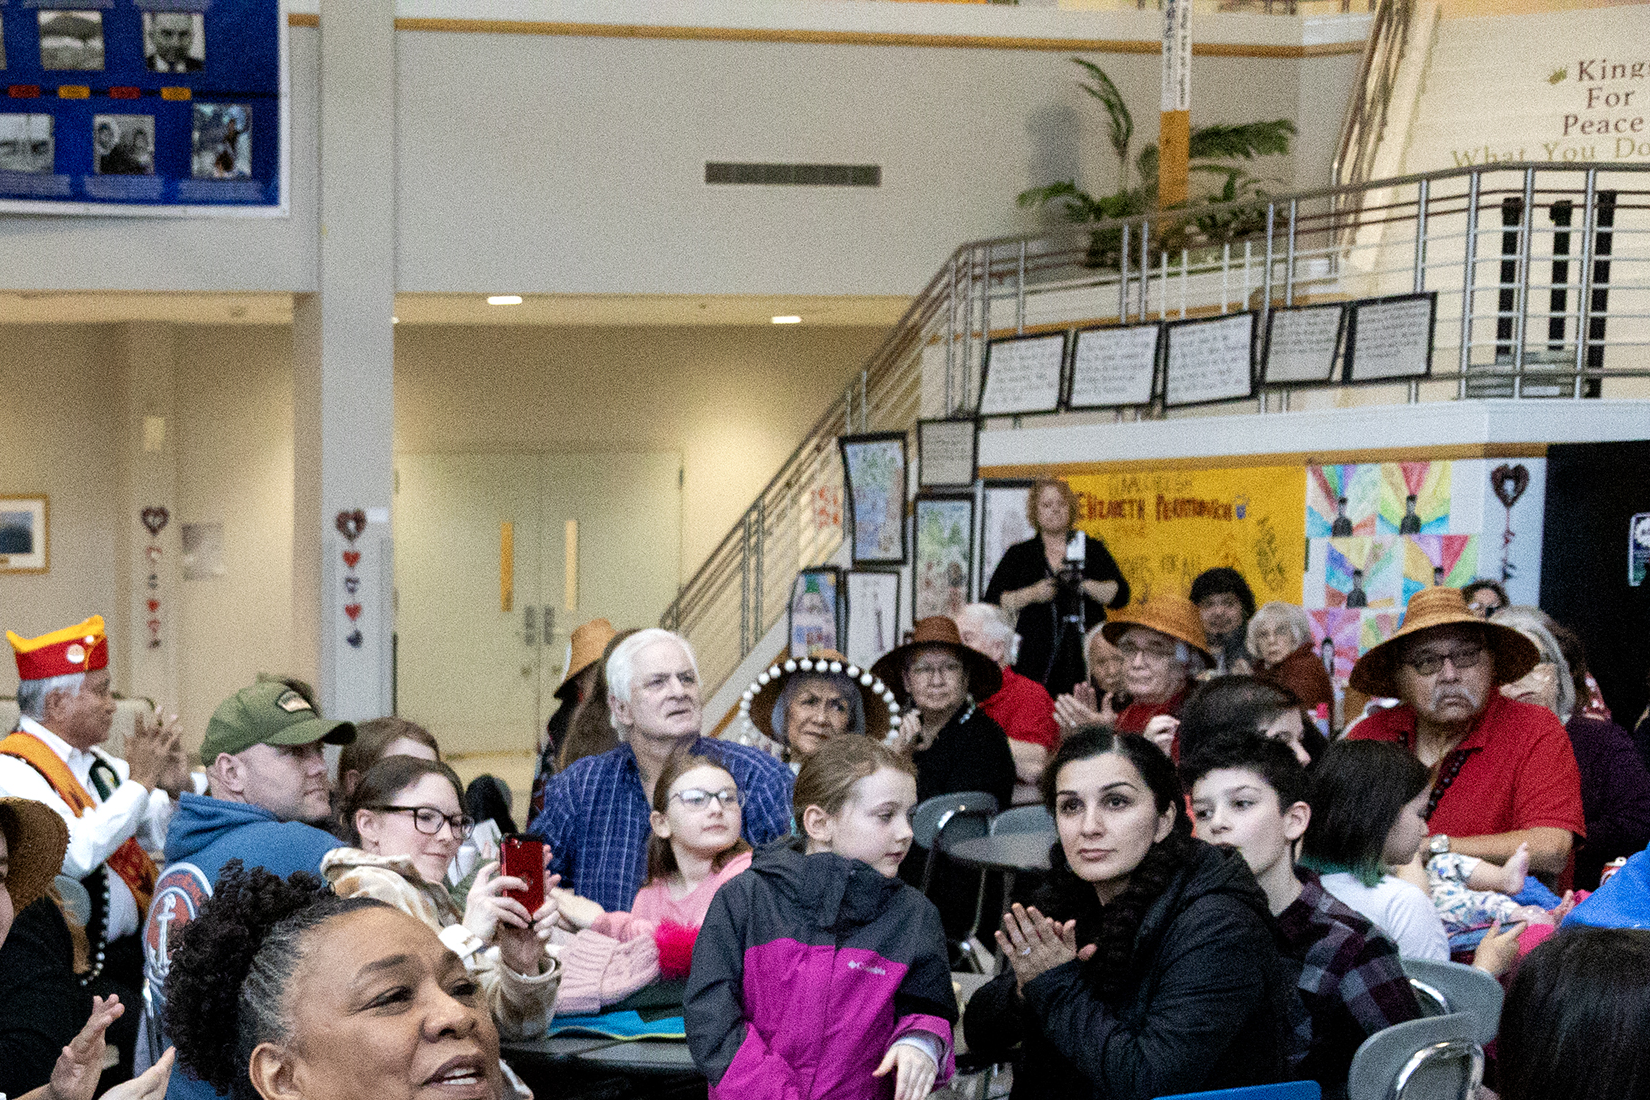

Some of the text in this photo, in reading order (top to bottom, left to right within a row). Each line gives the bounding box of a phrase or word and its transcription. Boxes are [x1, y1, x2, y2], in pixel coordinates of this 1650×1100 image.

[1586, 86, 1636, 109] For
[1563, 113, 1645, 137] Peace
[1451, 145, 1526, 168] What
[1542, 141, 1597, 162] You
